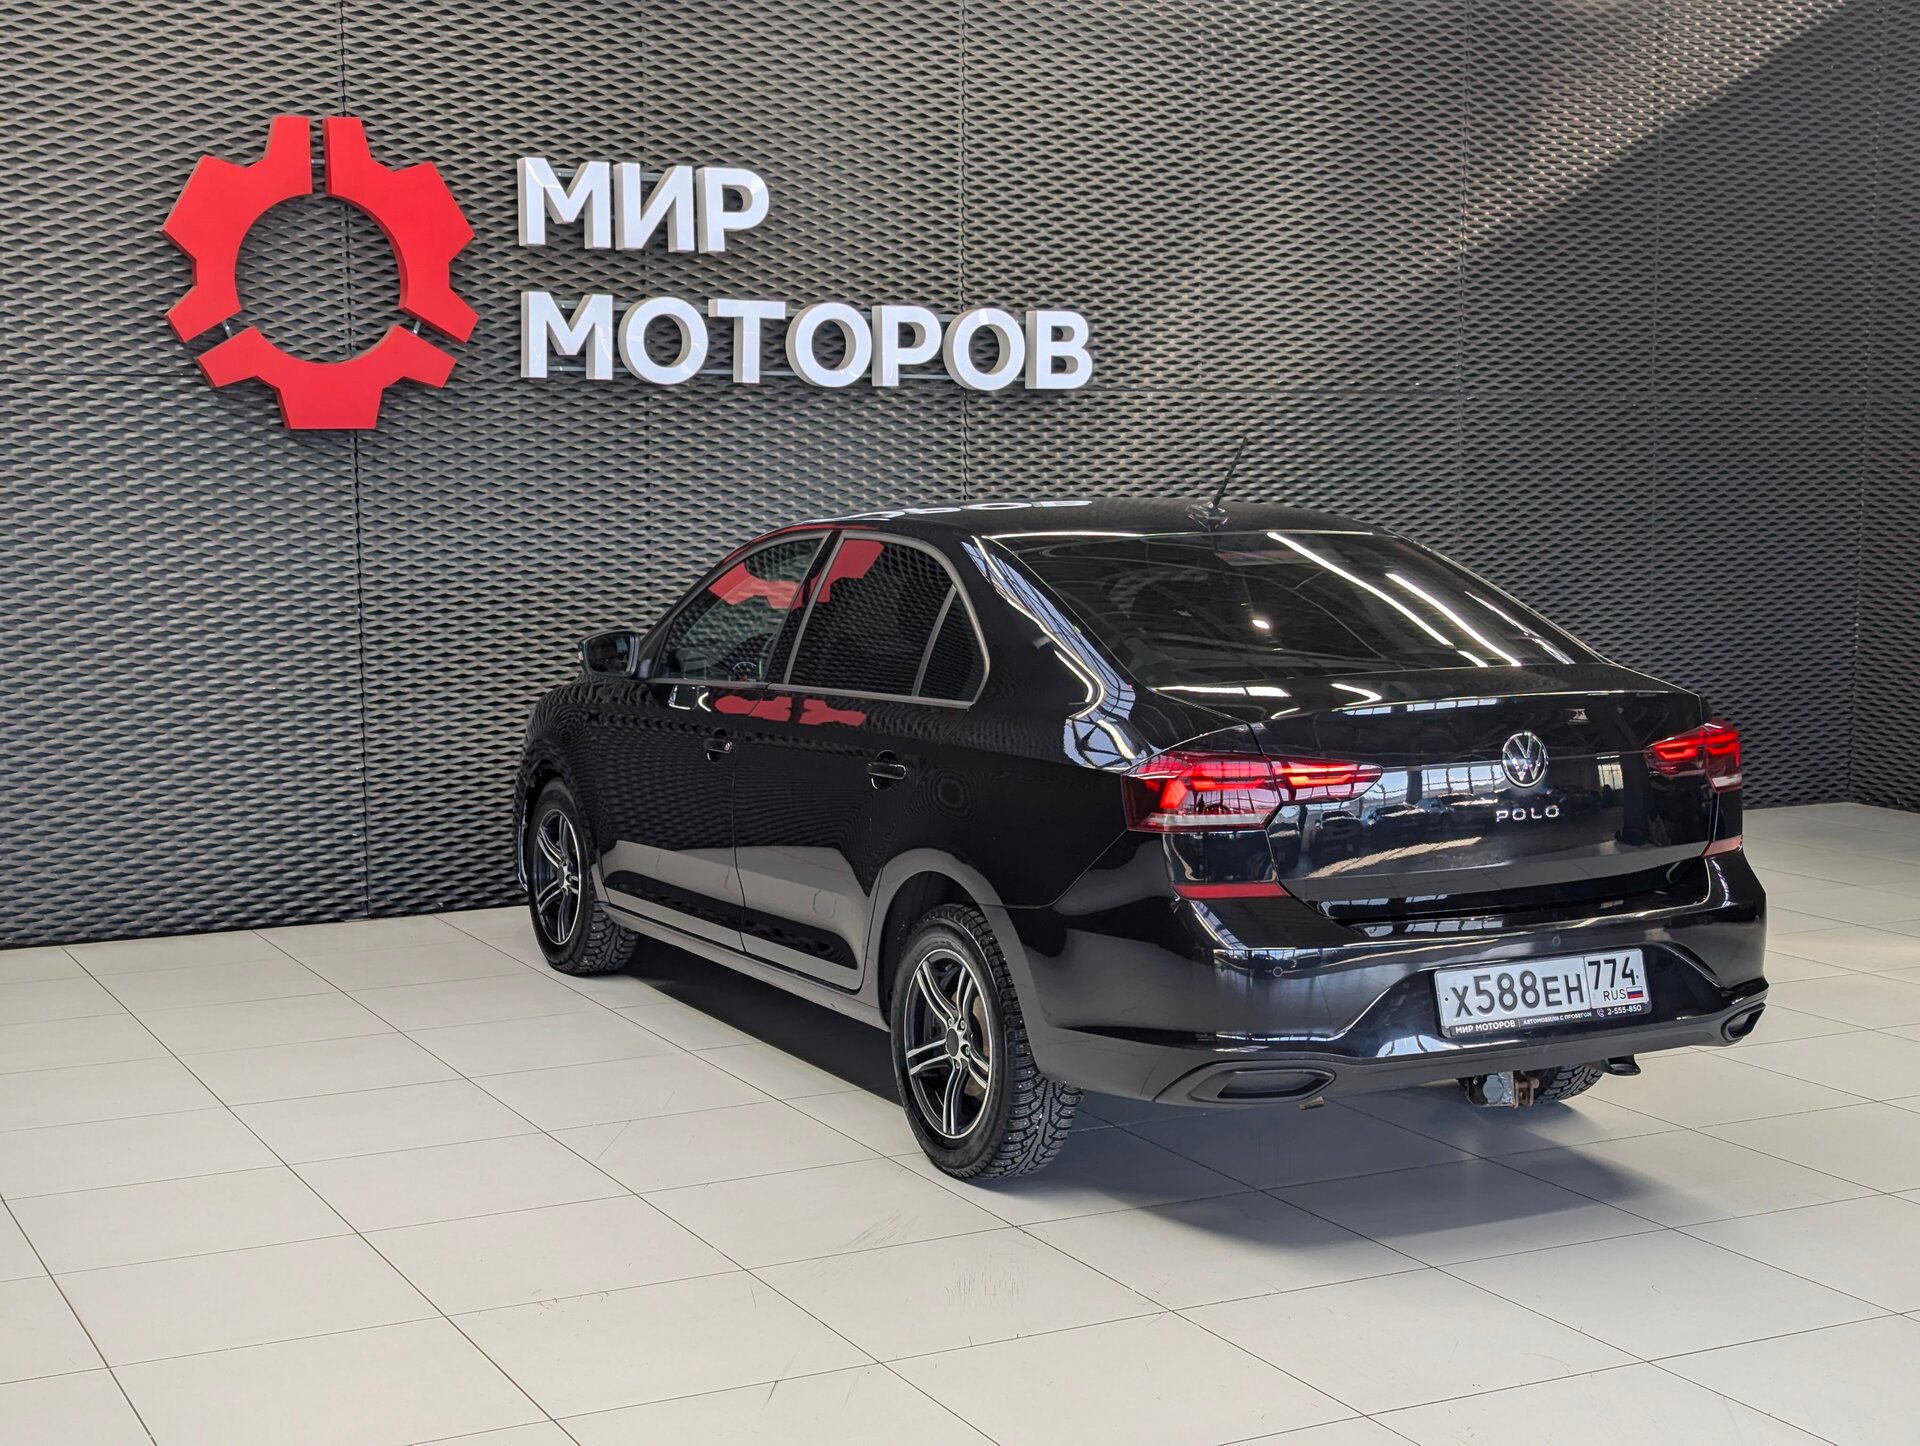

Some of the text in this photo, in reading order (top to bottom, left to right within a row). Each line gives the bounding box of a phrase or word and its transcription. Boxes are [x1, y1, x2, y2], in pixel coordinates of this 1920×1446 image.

[517, 157, 770, 253] МИР
[520, 291, 1093, 391] МОТОРОВ
[1496, 805, 1560, 822] POLO
[1588, 957, 1636, 990] 774
[1603, 989, 1627, 1001] RUS
[1455, 1023, 1474, 1034] МИР
[1476, 1020, 1516, 1032] МОТОРОВ
[1523, 1016, 1559, 1025] АВТОМОБИЛИ
[1565, 1011, 1593, 1020] ПРОБЕГОМ
[1607, 1004, 1642, 1015] 2-555-850
